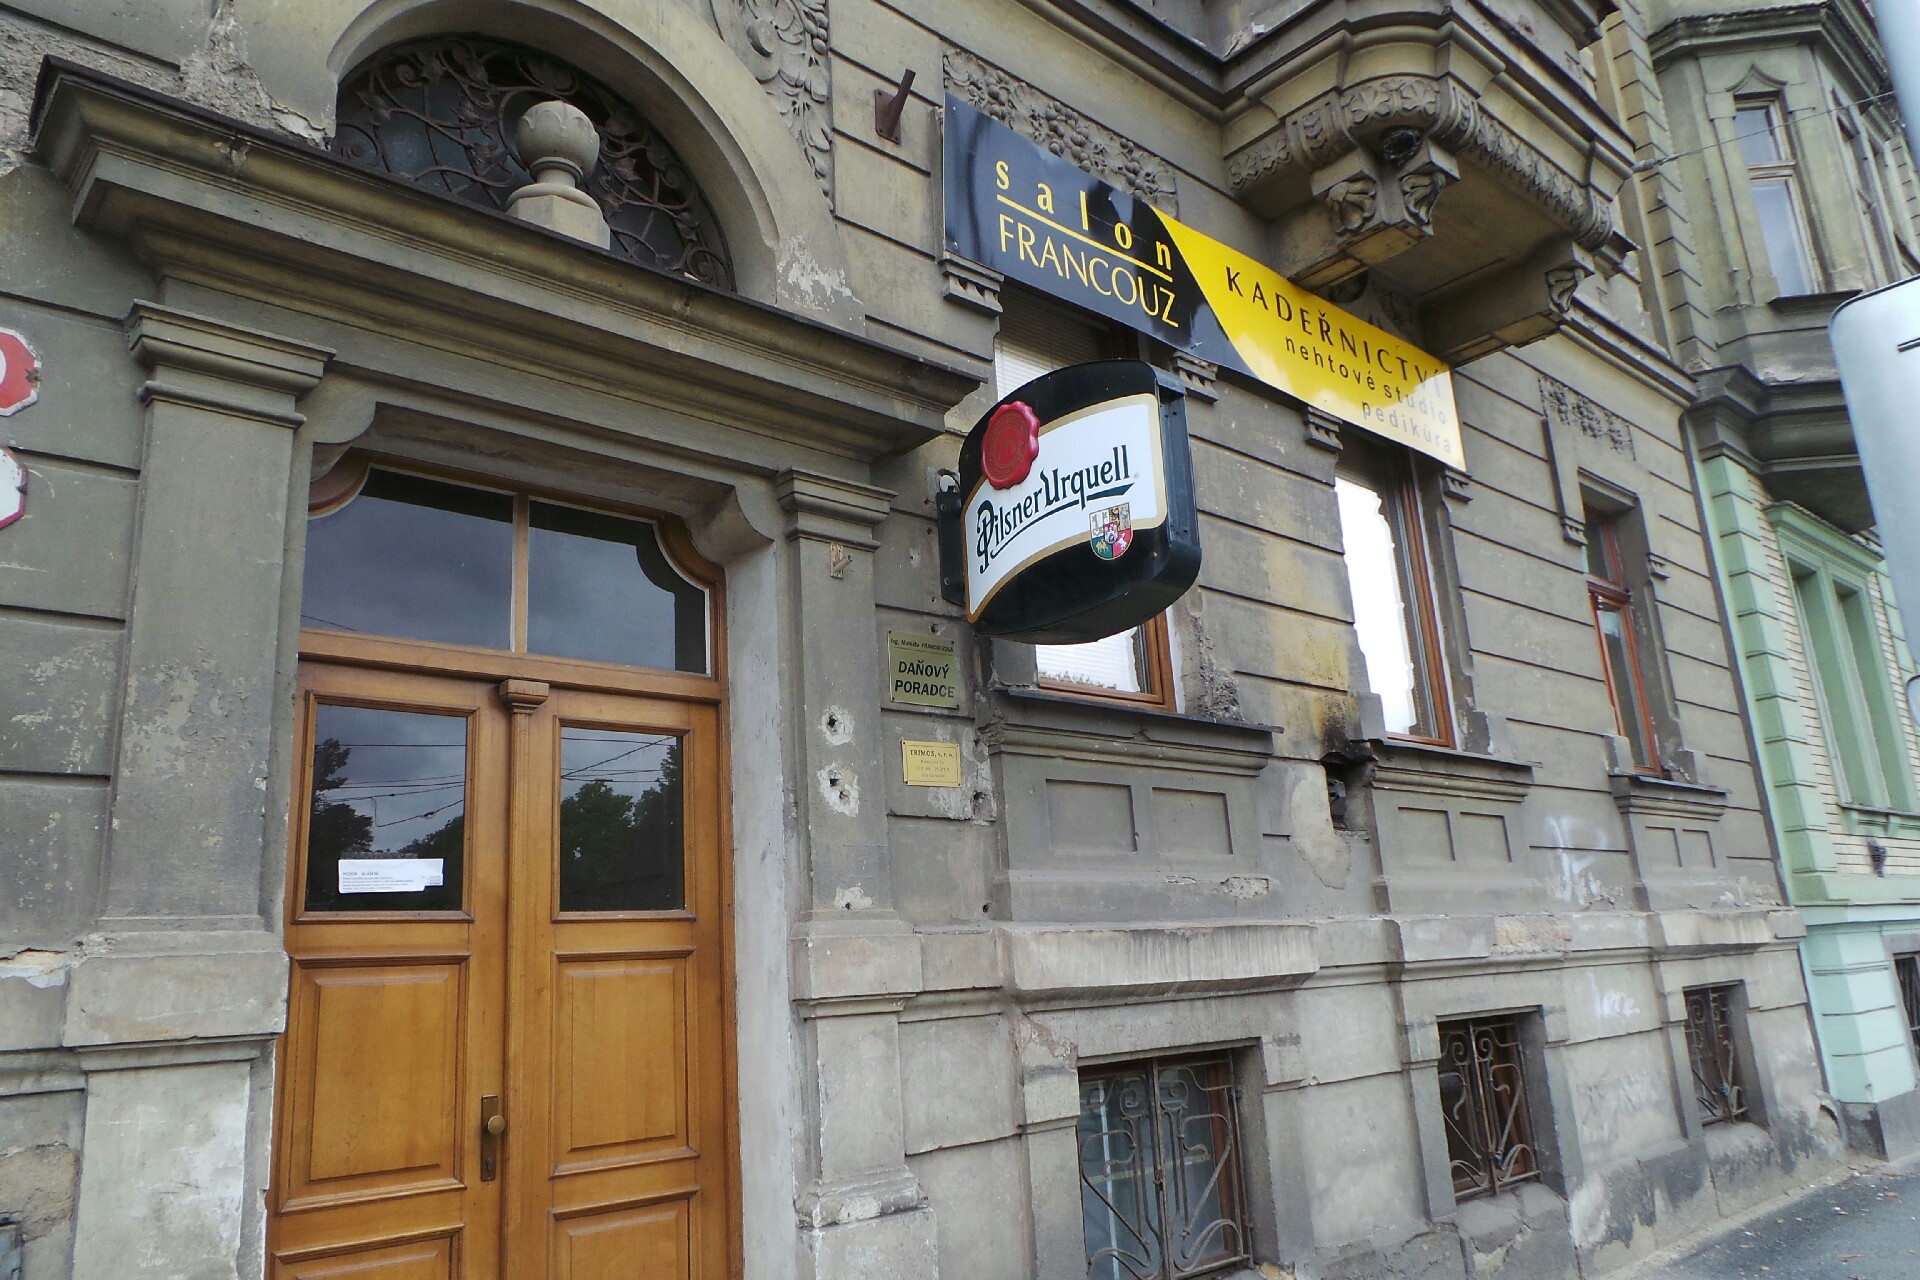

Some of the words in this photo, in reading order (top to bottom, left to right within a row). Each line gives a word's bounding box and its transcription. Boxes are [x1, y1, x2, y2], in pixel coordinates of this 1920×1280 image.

[995, 160, 1173, 271] salon
[999, 213, 1179, 328] FRANCOUZ
[1225, 266, 1441, 397] KADEŘNICTVÍ
[1285, 336, 1375, 391] nehtové
[1384, 383, 1447, 425] studio
[976, 486, 1043, 575] Pilsner
[1040, 444, 1130, 511] Urquell
[894, 679, 956, 699] PORADCE
[898, 659, 950, 679] DAŇOVÝ
